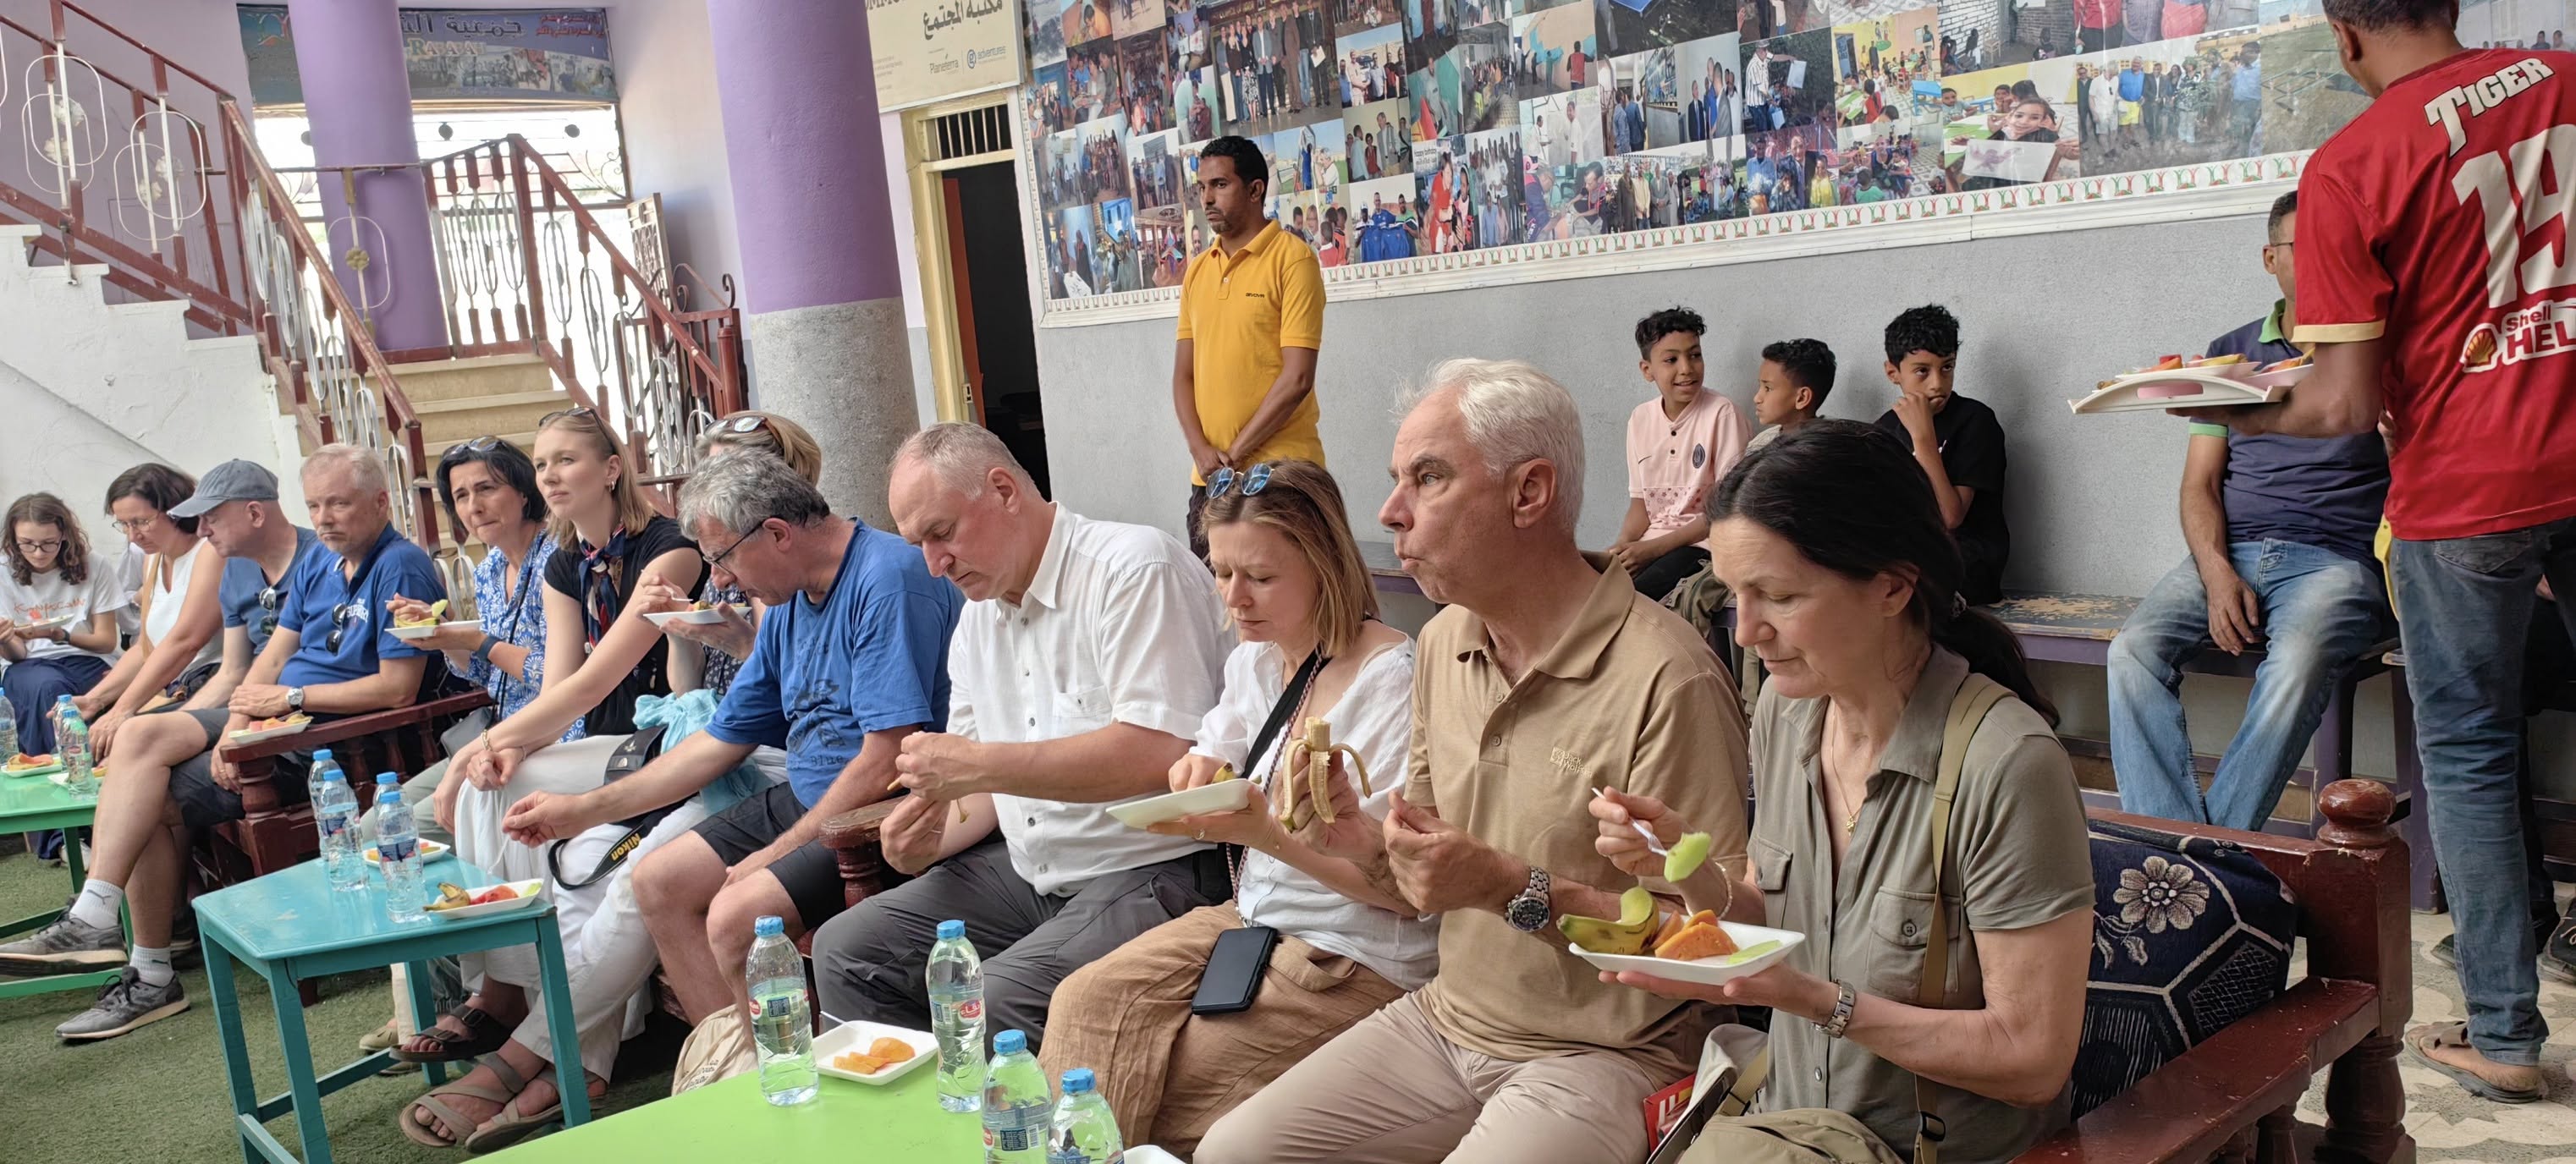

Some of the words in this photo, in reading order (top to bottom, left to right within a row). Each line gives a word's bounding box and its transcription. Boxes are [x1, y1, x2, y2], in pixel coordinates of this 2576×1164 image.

[446, 15, 522, 38] جمعية
[2424, 58, 2556, 158] TIGER
[2452, 124, 2576, 309] 19
[2506, 305, 2551, 332] Shell
[611, 832, 641, 861] Nikon
